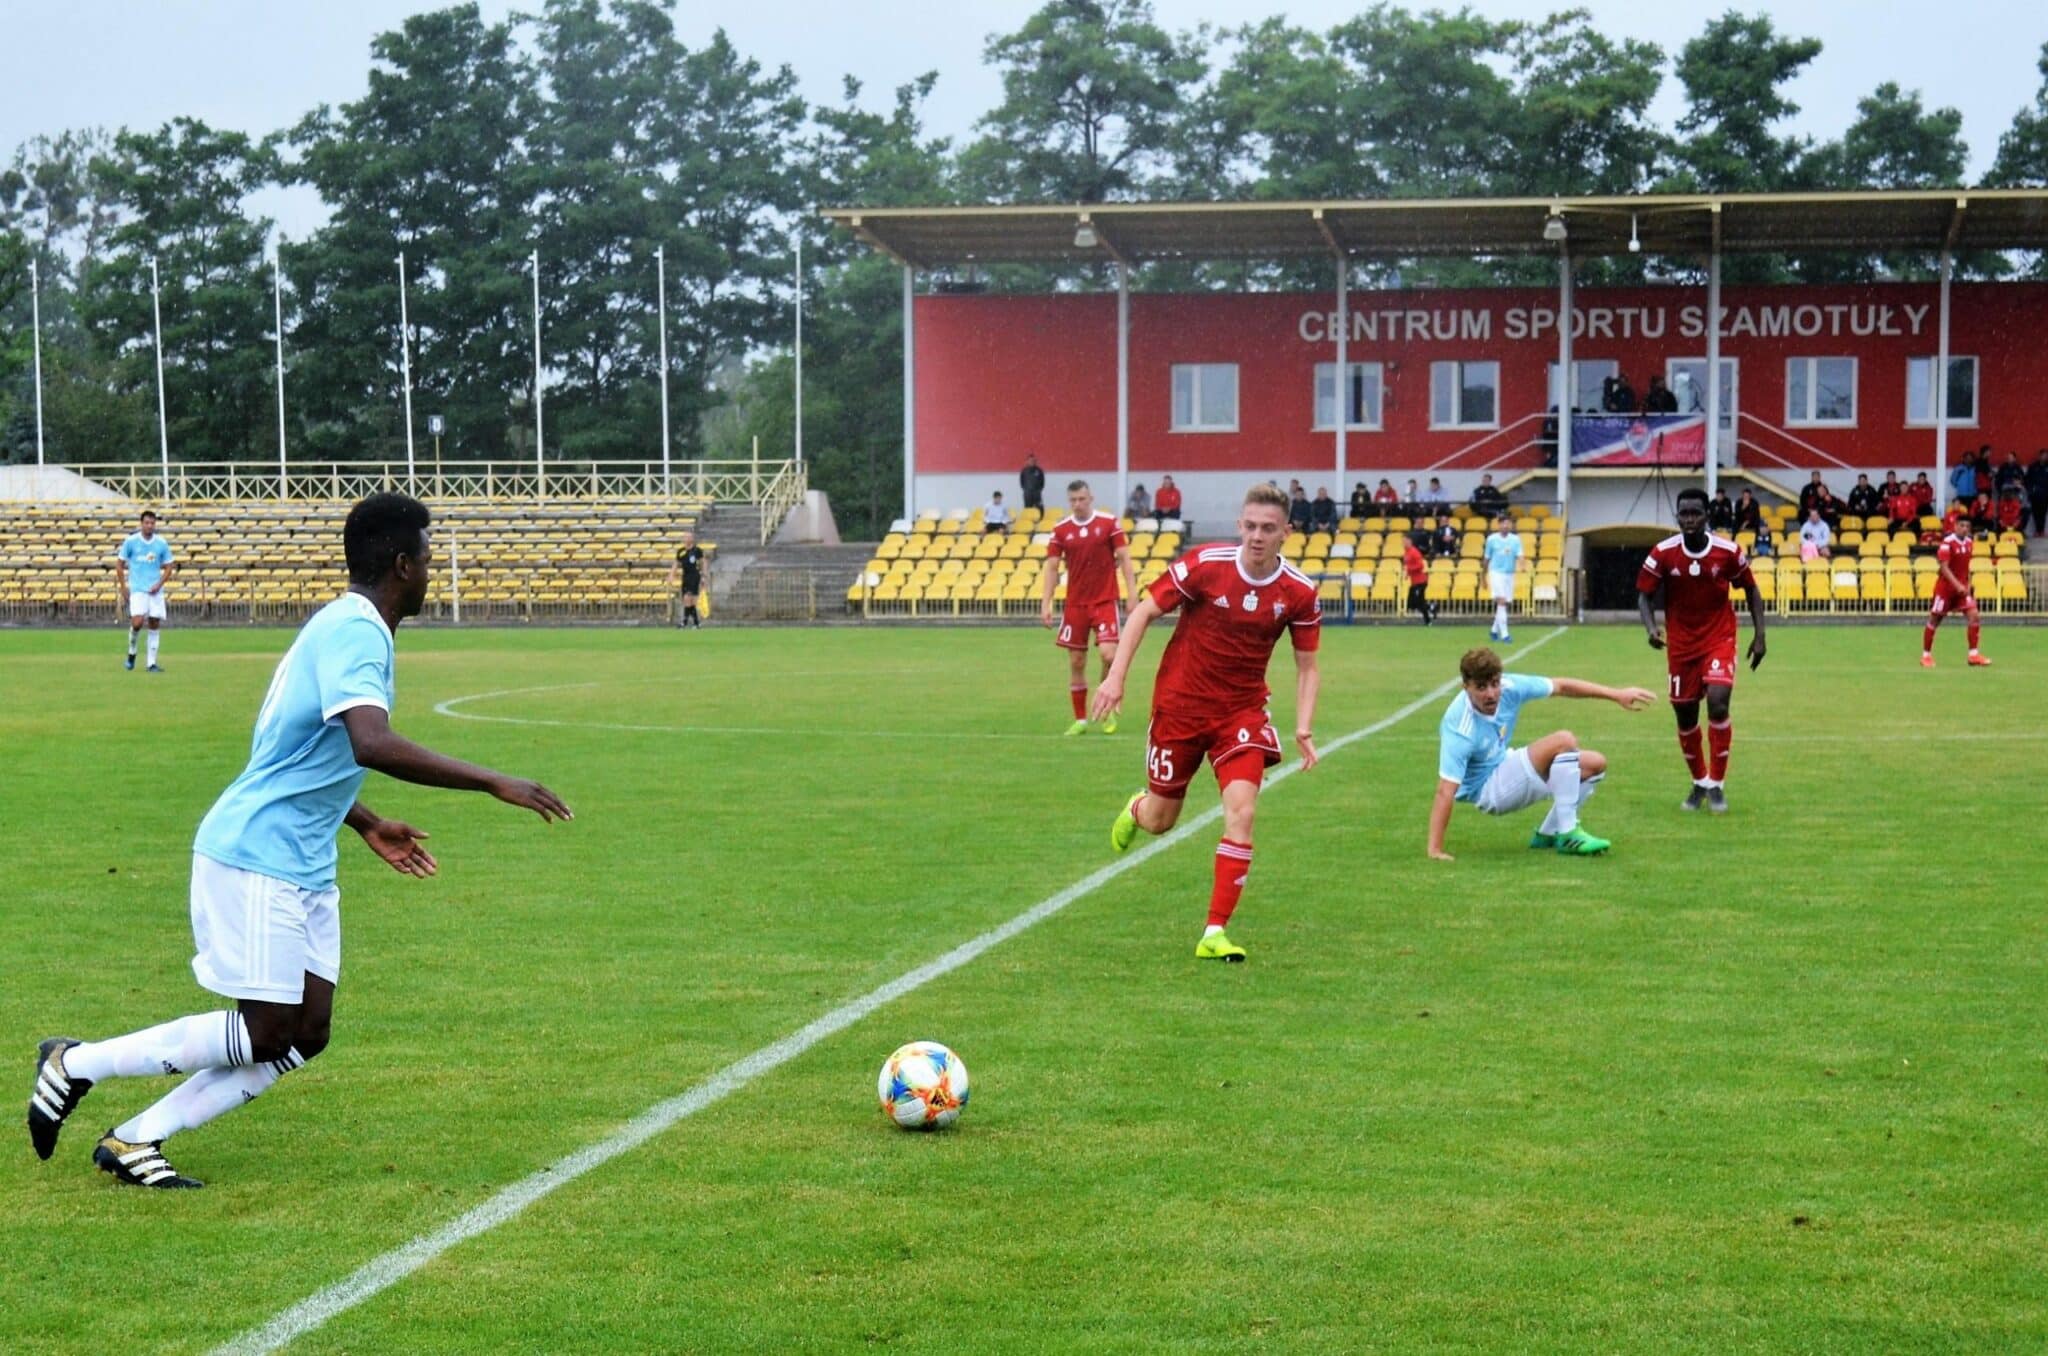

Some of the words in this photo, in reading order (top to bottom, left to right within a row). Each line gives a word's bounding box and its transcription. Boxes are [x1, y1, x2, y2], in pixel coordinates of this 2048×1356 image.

[1298, 309, 1491, 342] CENTRUM
[1504, 307, 1666, 339] SPORTU
[1679, 304, 1930, 337] SZAMOTUŁY
[1150, 746, 1174, 781] 45
